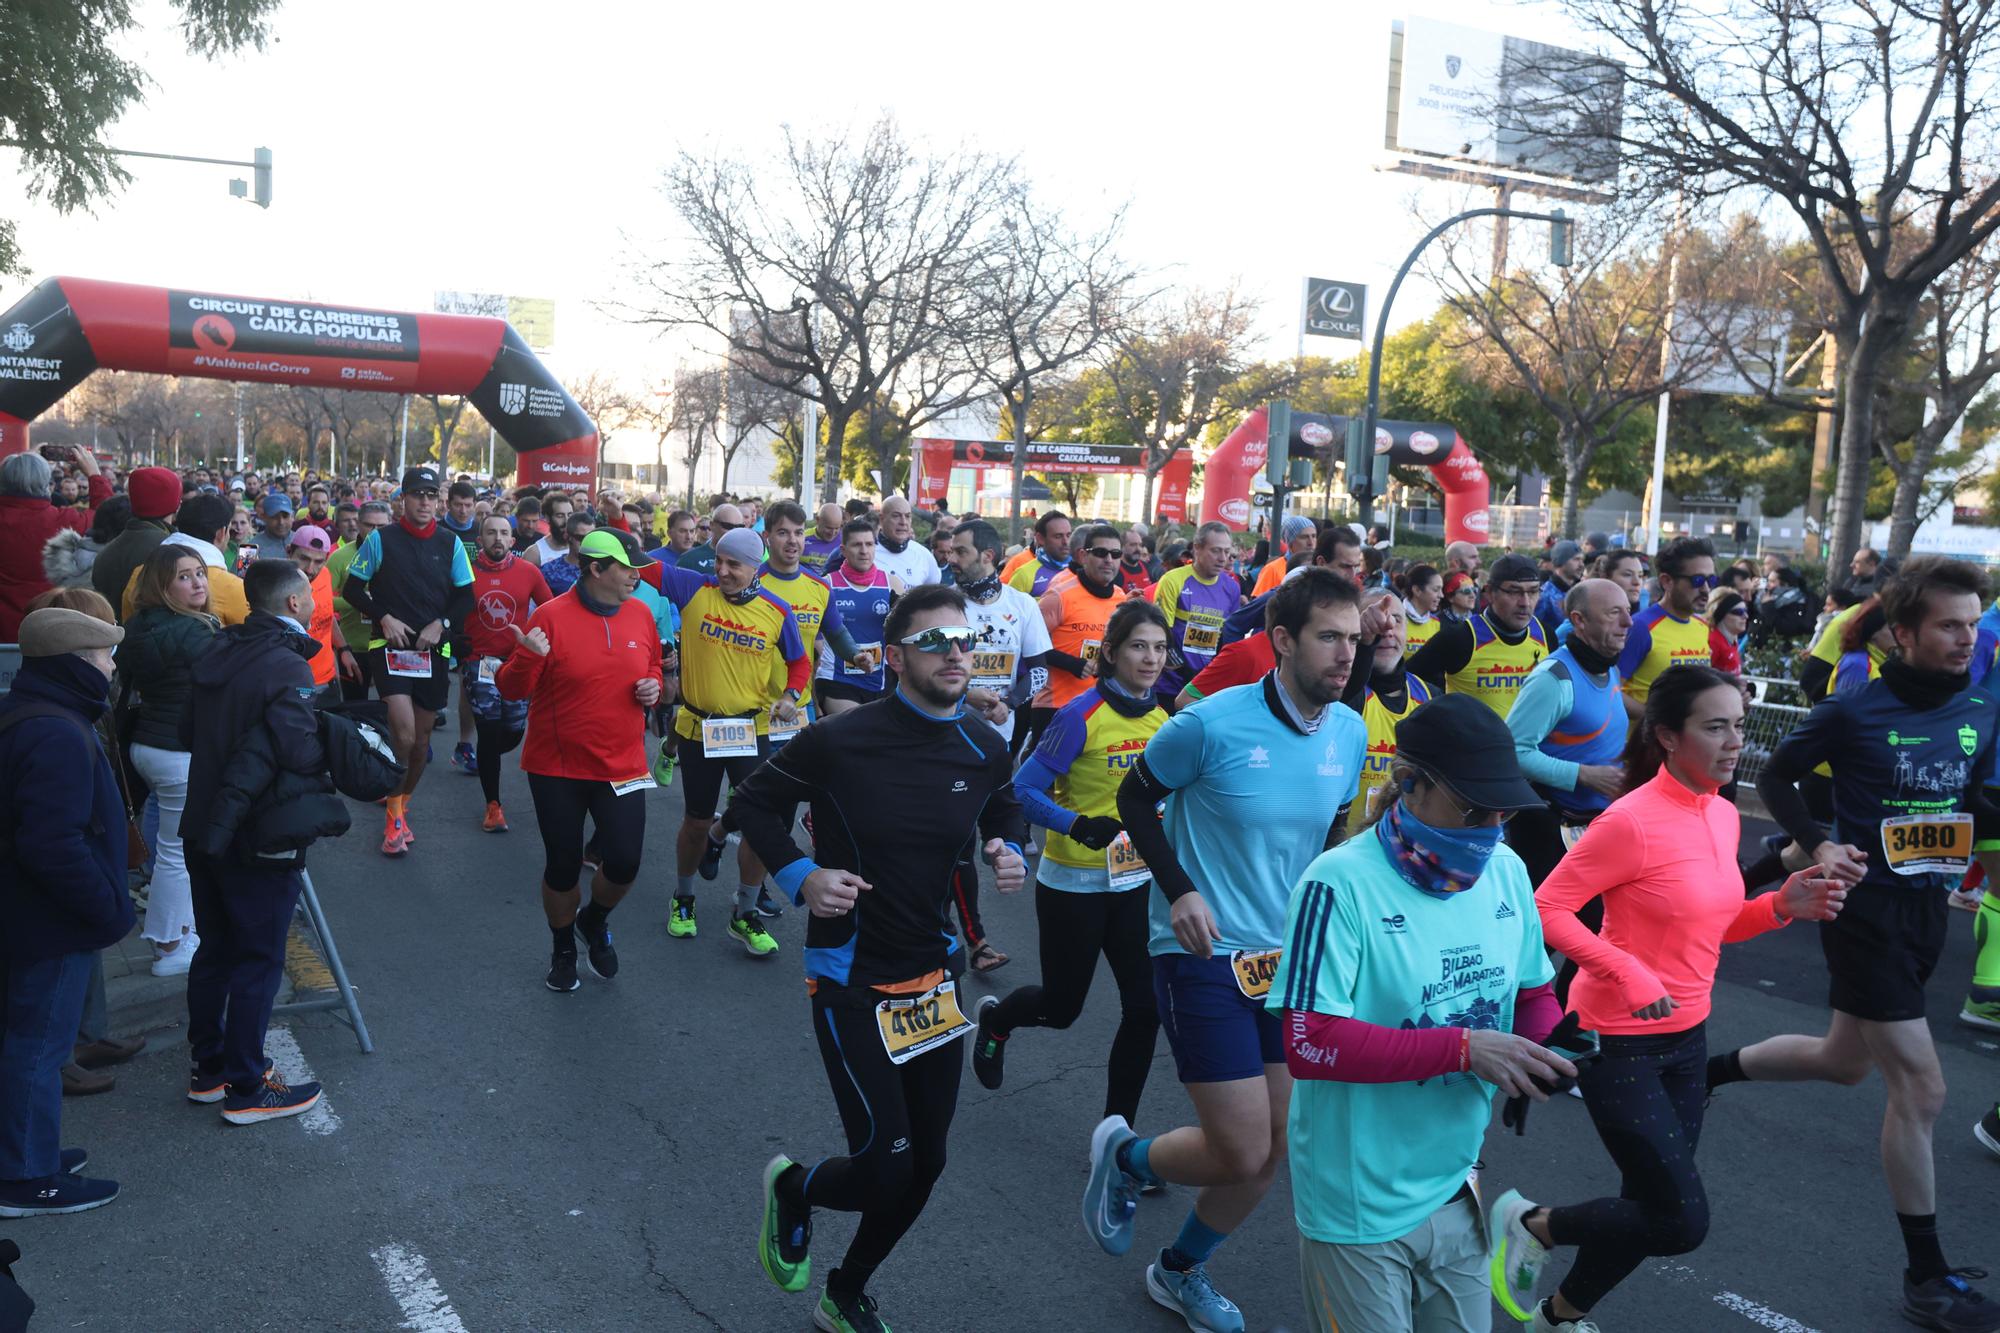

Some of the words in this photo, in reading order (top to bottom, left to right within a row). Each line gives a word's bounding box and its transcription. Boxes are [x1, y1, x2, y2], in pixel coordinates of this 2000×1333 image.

[188, 297, 265, 316] CIRCUIT
[269, 305, 296, 319] DE
[298, 308, 400, 329] CARRERES
[1310, 318, 1360, 333] LEXUS
[0, 356, 62, 369] NTAMENT
[193, 355, 311, 375] #ValènciaCorre
[1036, 445, 1047, 454] DE
[1048, 445, 1091, 455] CARRERES
[700, 620, 766, 651] runners
[973, 654, 1006, 670] 3424
[711, 726, 746, 741] 4109
[1107, 769, 1127, 777] CIUT
[1892, 825, 1956, 851] 3480
[1441, 953, 1484, 981] BILBAO
[1420, 979, 1453, 1005] NIGHT
[1453, 965, 1506, 994] MARATHON
[891, 999, 946, 1037] 4182
